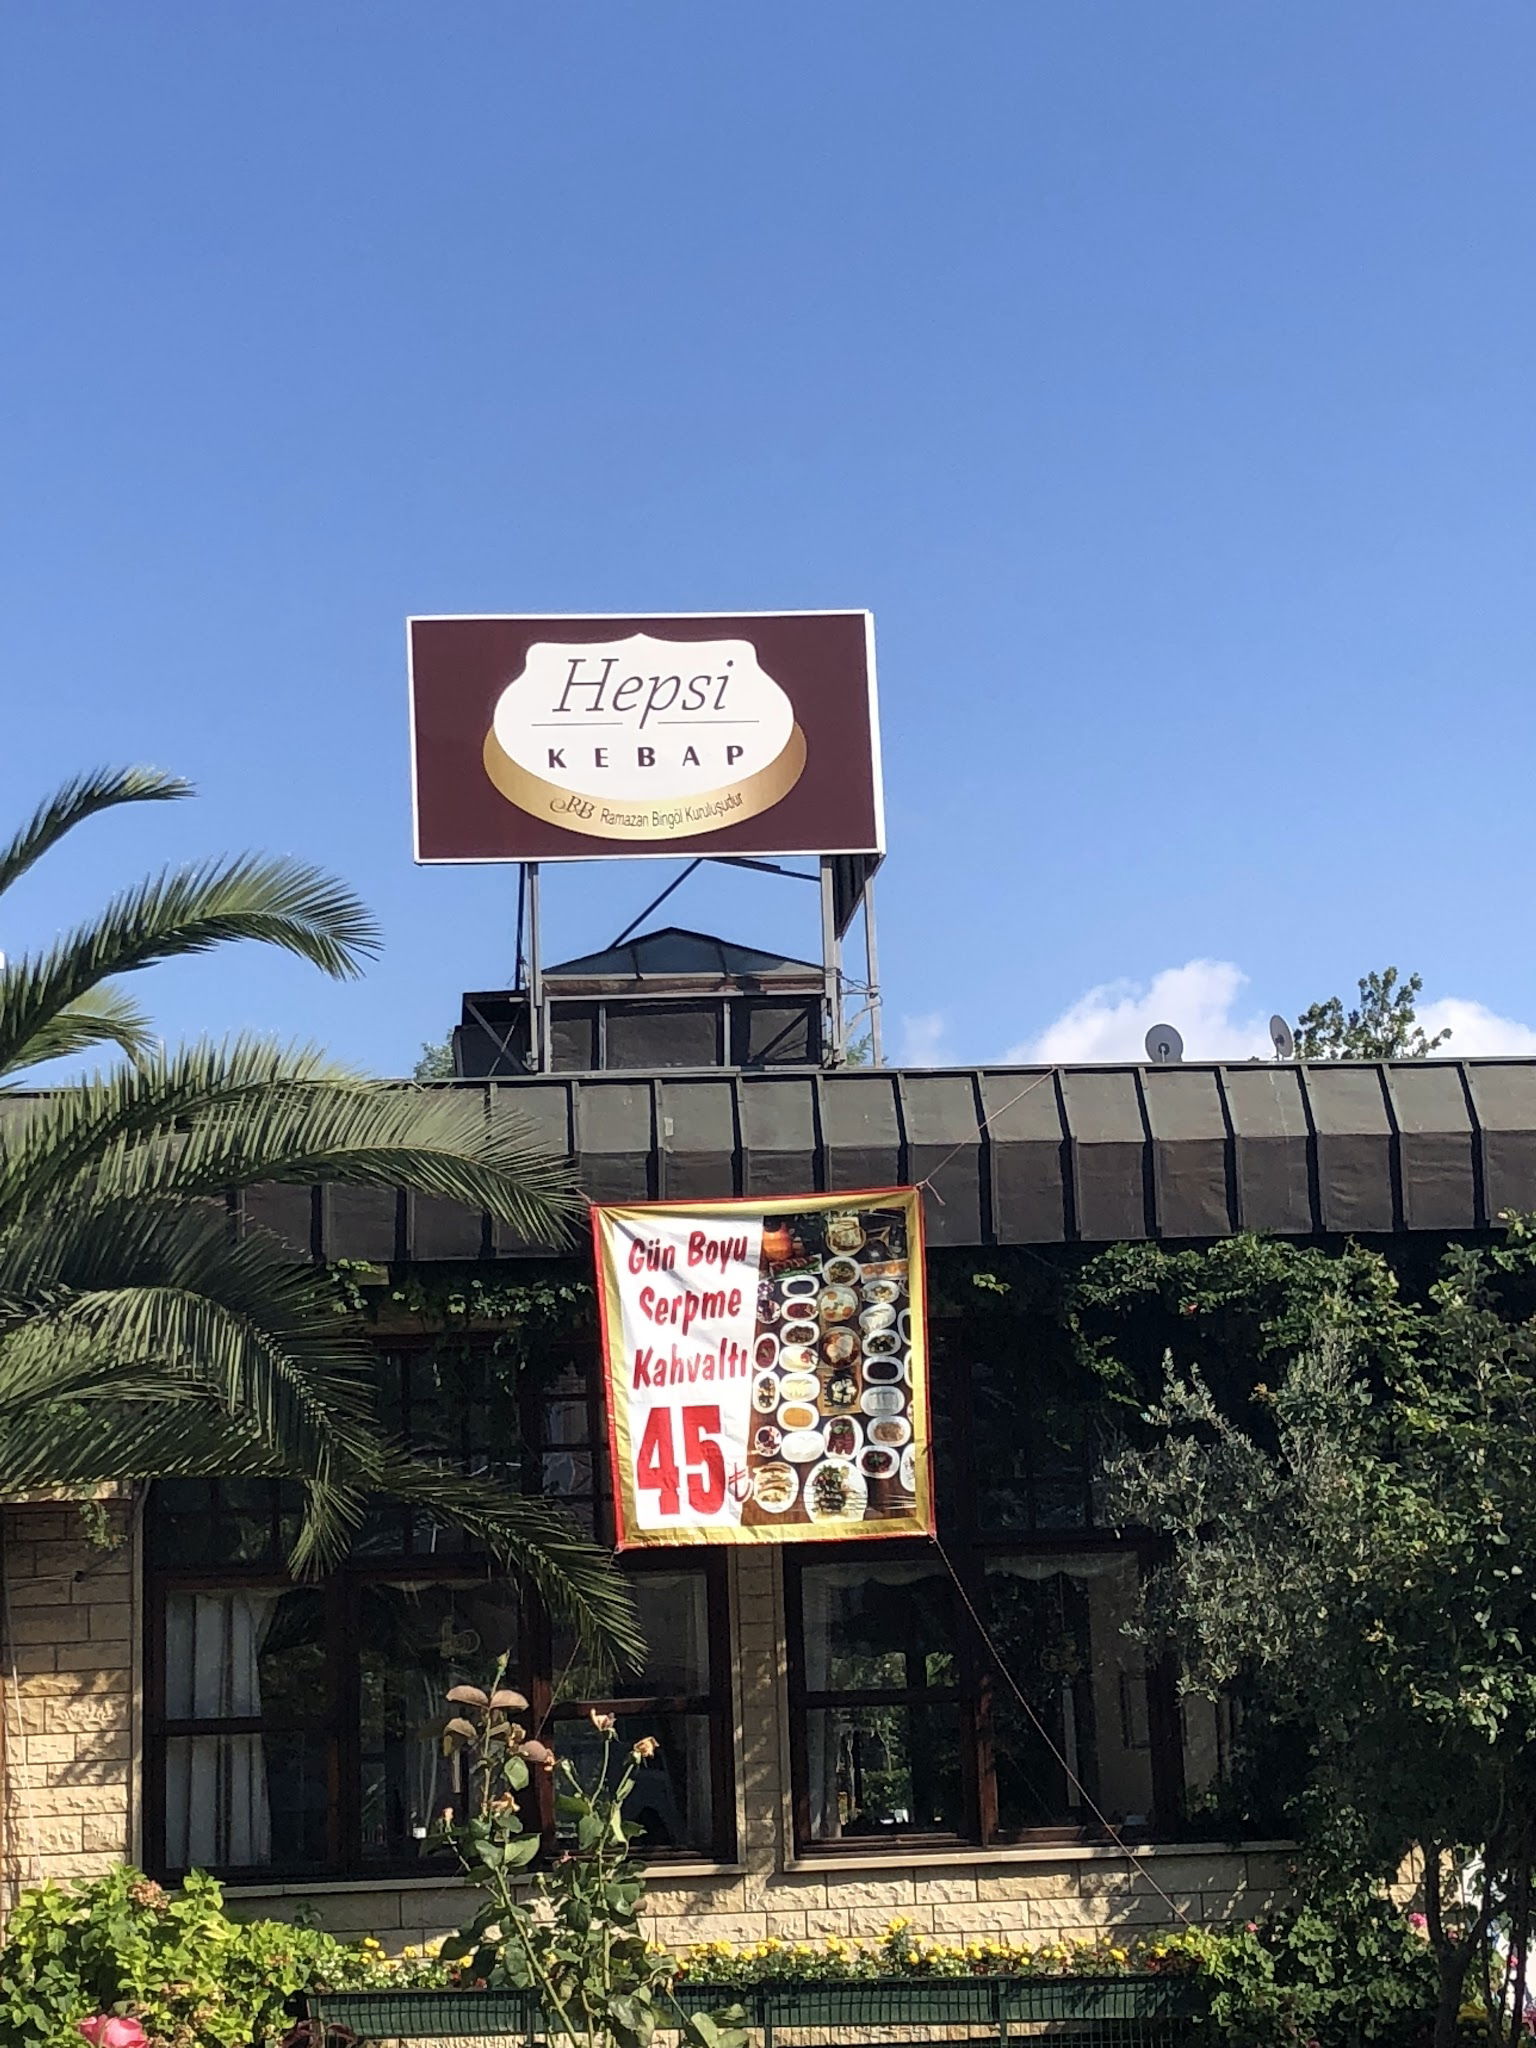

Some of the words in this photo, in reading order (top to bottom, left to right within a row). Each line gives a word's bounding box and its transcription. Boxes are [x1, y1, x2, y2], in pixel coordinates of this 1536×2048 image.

[552, 657, 734, 729] Hepsi
[548, 745, 744, 769] KEBAP
[600, 808, 649, 827] Ramazan
[652, 809, 683, 829] Bingöl
[686, 793, 744, 821] Kuruluşudur
[628, 1237, 675, 1275] Gün
[688, 1230, 748, 1274] Boyu
[639, 1286, 742, 1335] Serpme
[633, 1337, 748, 1390] Kahvaltı
